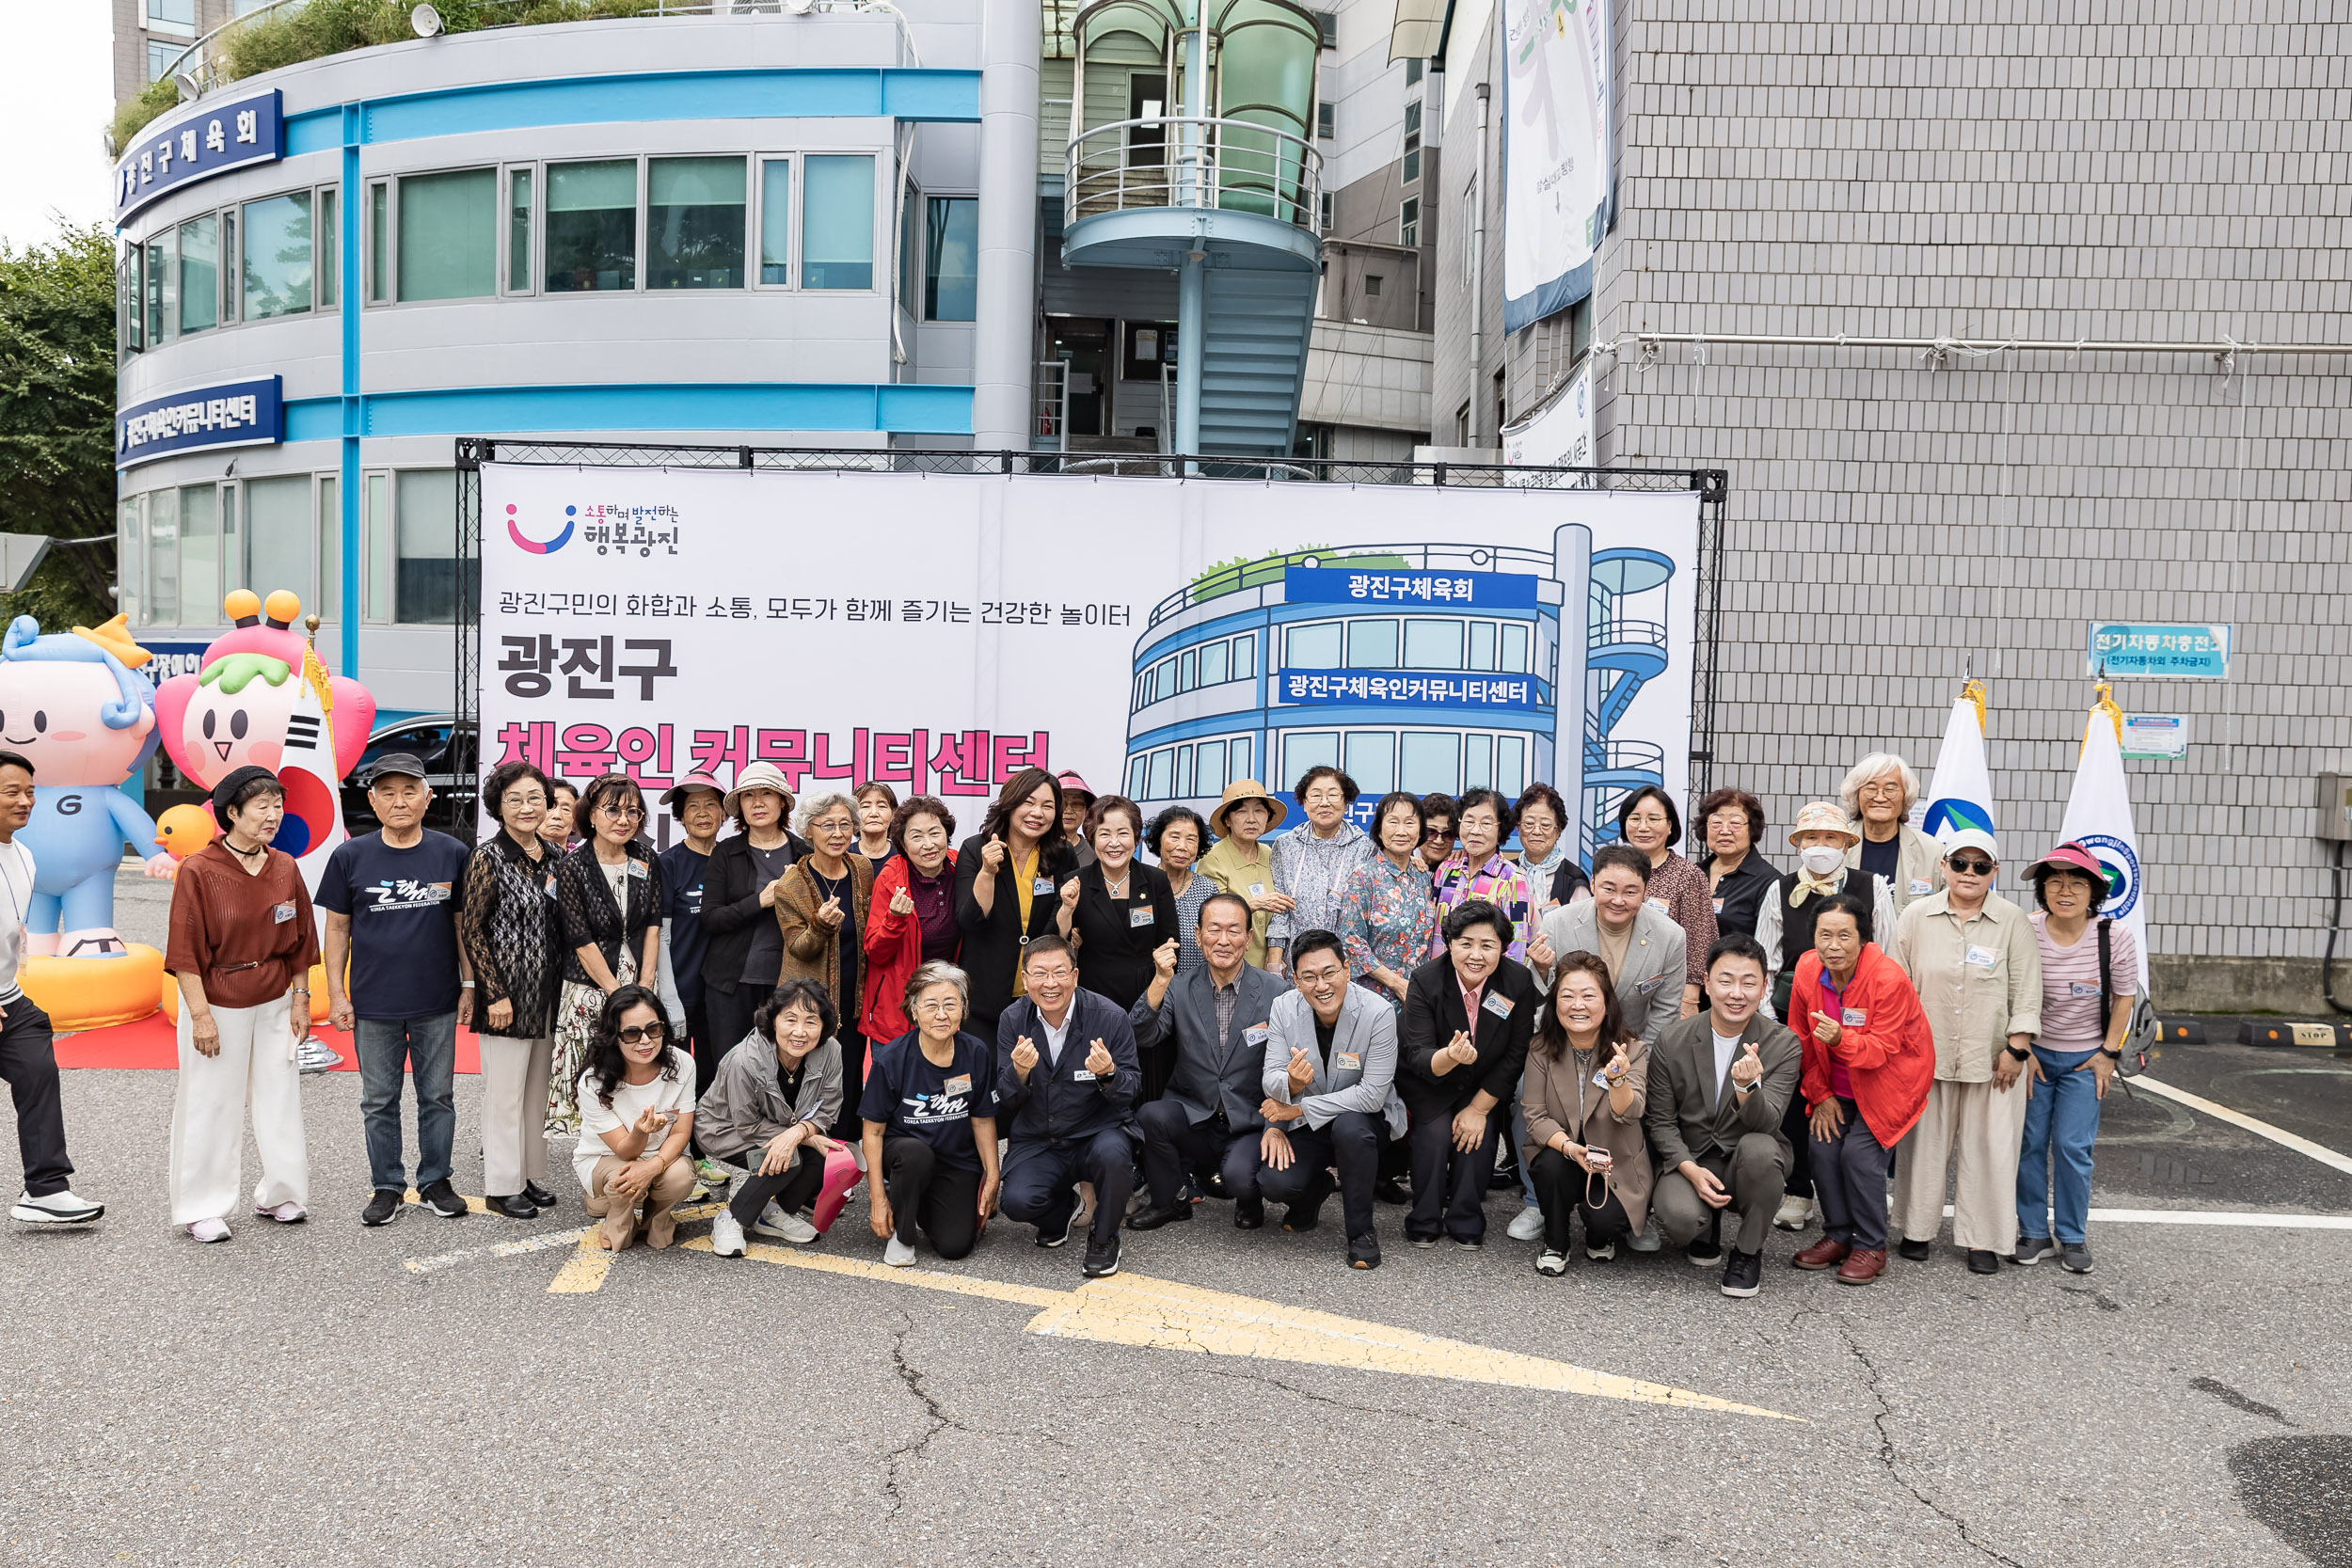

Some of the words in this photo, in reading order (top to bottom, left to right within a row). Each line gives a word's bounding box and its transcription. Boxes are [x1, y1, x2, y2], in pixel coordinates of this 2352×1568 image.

[125, 110, 257, 195] 광진구체육회
[127, 395, 256, 449] 광진구체육인커뮤니티센터
[584, 504, 629, 524] 소통하며
[632, 505, 679, 525] 발전하는
[584, 523, 678, 557] 행복광진
[1348, 575, 1473, 602] 광진구체육회
[499, 592, 617, 616] 광진구민의
[626, 594, 697, 617] 화합과
[706, 596, 757, 620] 소통,
[766, 597, 837, 621] 모두가
[846, 597, 892, 622] 함께
[901, 600, 971, 623] 즐기는
[981, 602, 1052, 625] 건강한
[1060, 604, 1130, 626] 놀이터
[498, 634, 677, 701] 광진구
[1288, 674, 1528, 704] 광진구체육인커뮤니티센터
[494, 721, 674, 790] 체육인
[689, 724, 1050, 798] 커뮤니티센터
[56, 795, 83, 816] G
